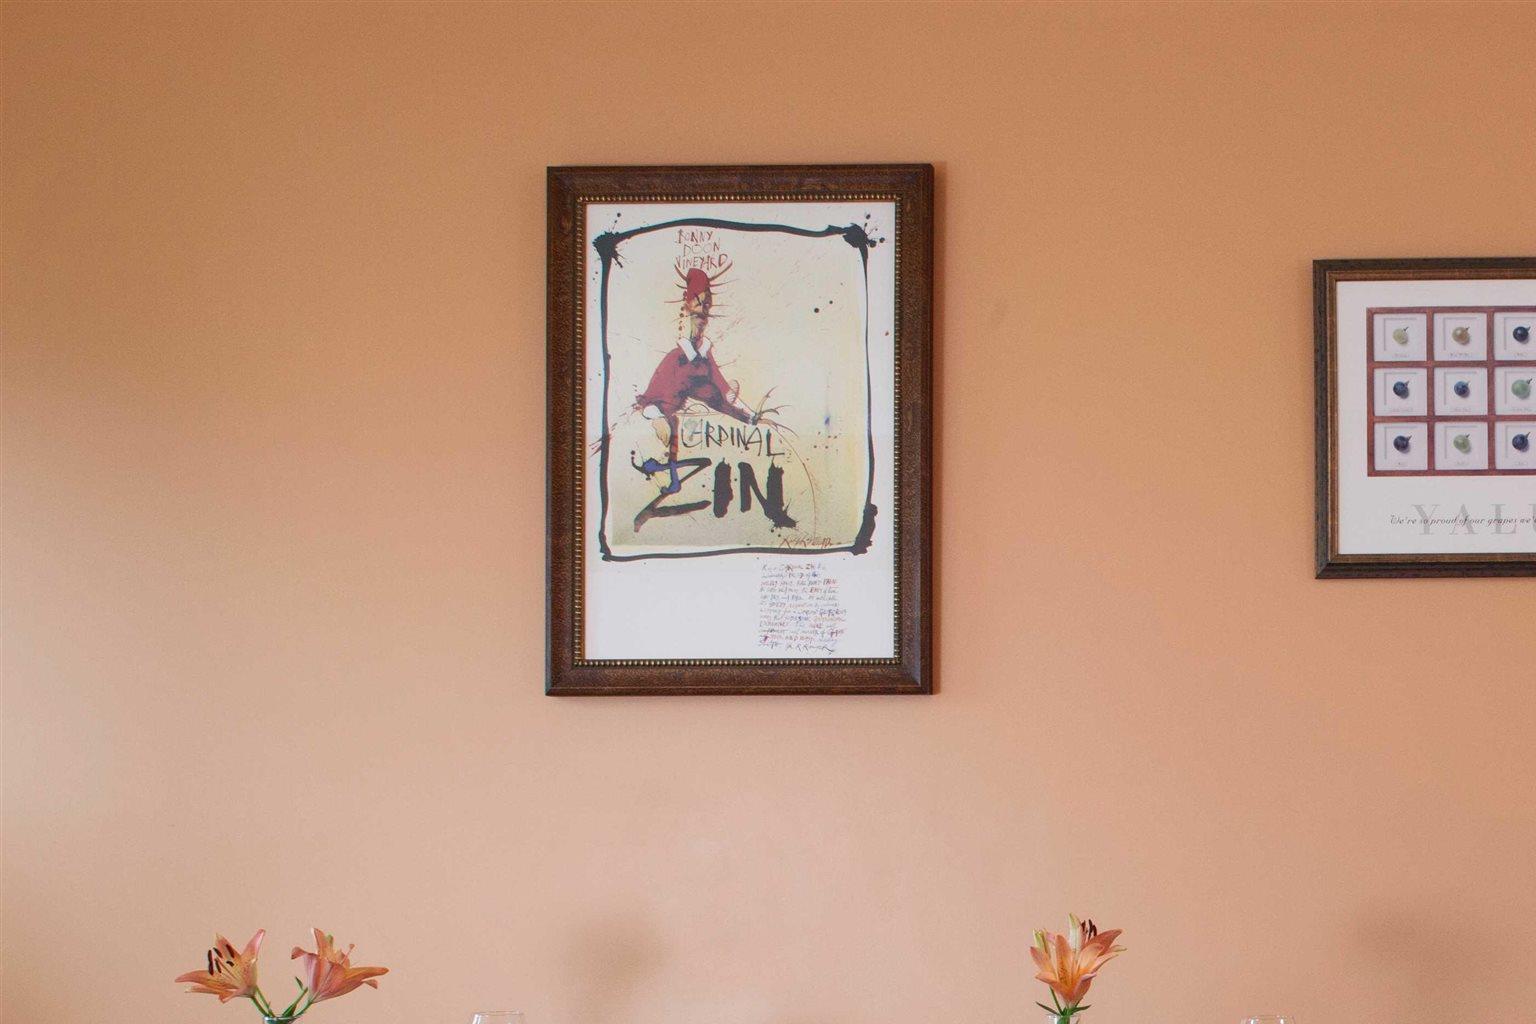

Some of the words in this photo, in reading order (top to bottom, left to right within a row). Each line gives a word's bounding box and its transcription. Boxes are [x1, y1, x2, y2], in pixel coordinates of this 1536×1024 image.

[681, 417, 785, 456] CARDINAL
[631, 457, 797, 532] ZIN
[1390, 514, 1417, 525] We're
[1429, 515, 1458, 527] proud
[1459, 514, 1470, 528] of
[1487, 518, 1518, 528] grapes
